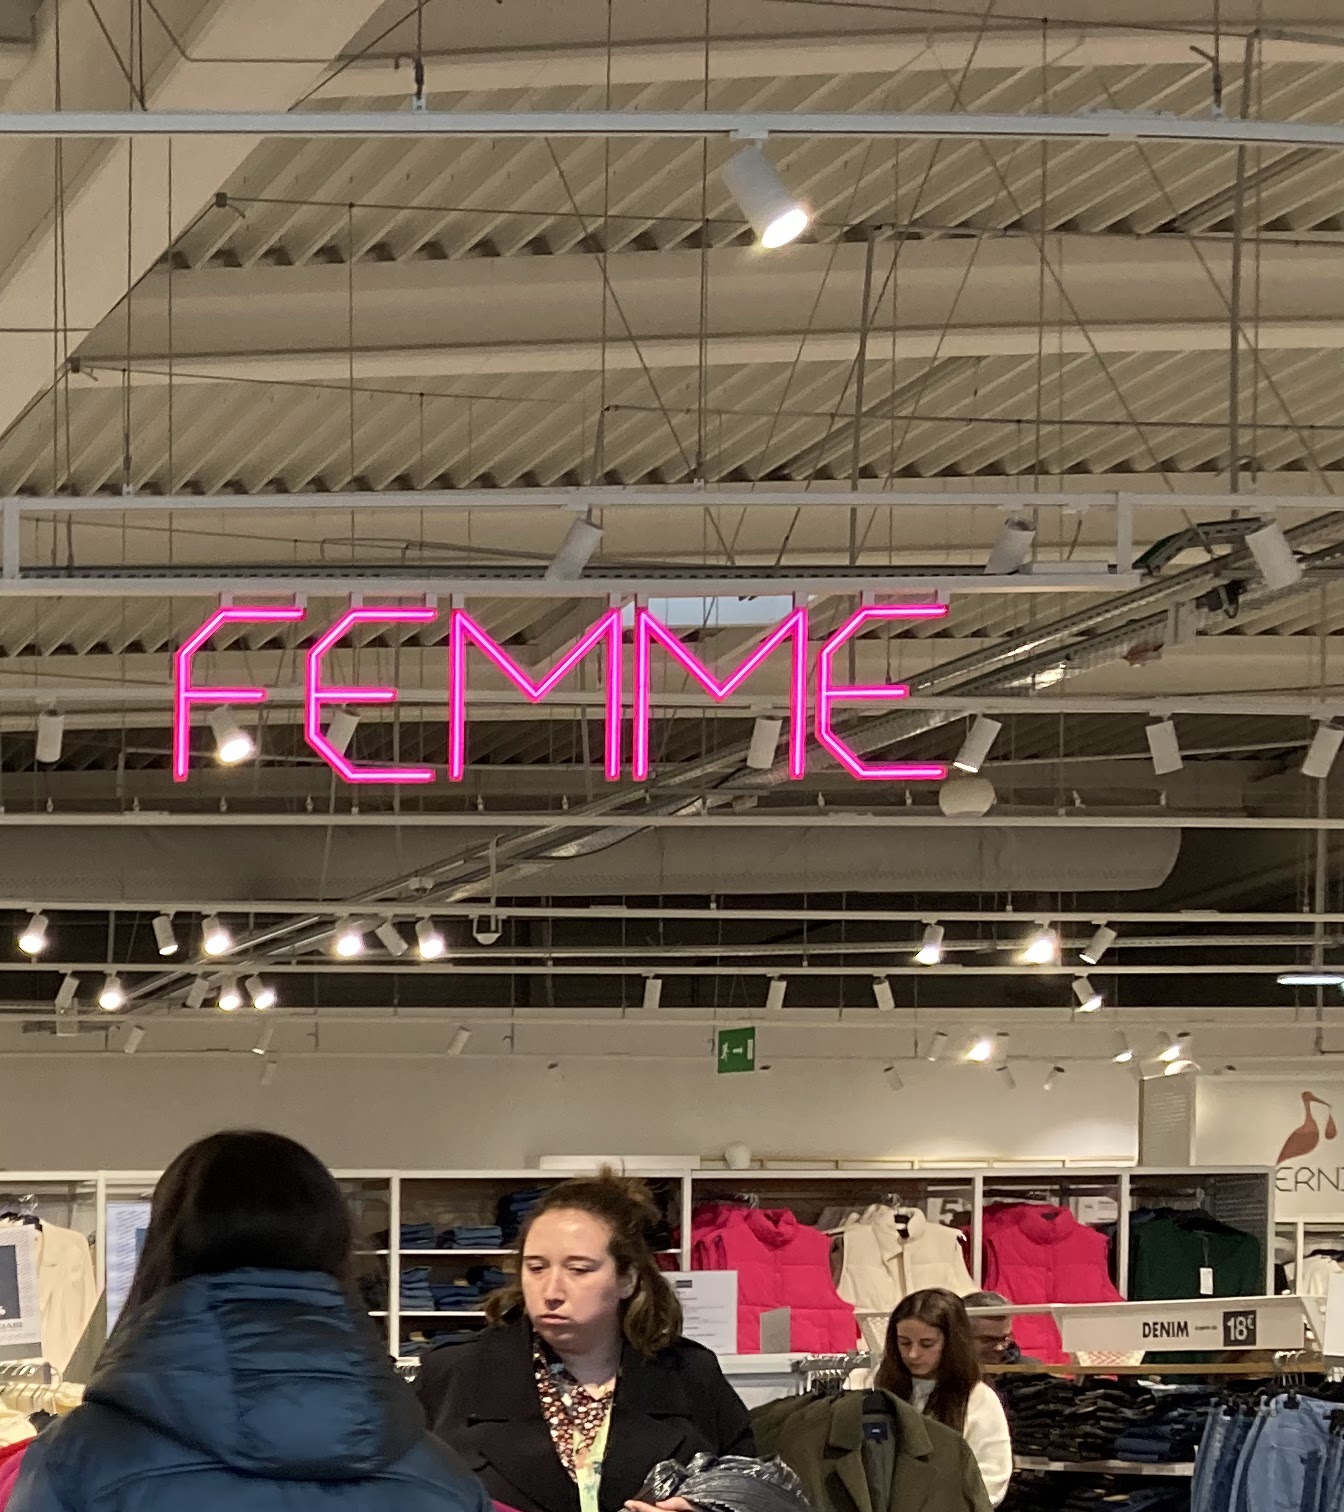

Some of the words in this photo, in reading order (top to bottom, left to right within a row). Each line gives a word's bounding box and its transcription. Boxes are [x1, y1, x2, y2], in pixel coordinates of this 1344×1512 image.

[172, 604, 950, 782] FEMME
[1142, 1320, 1189, 1338] DENIM
[1226, 1314, 1255, 1341] 18€
